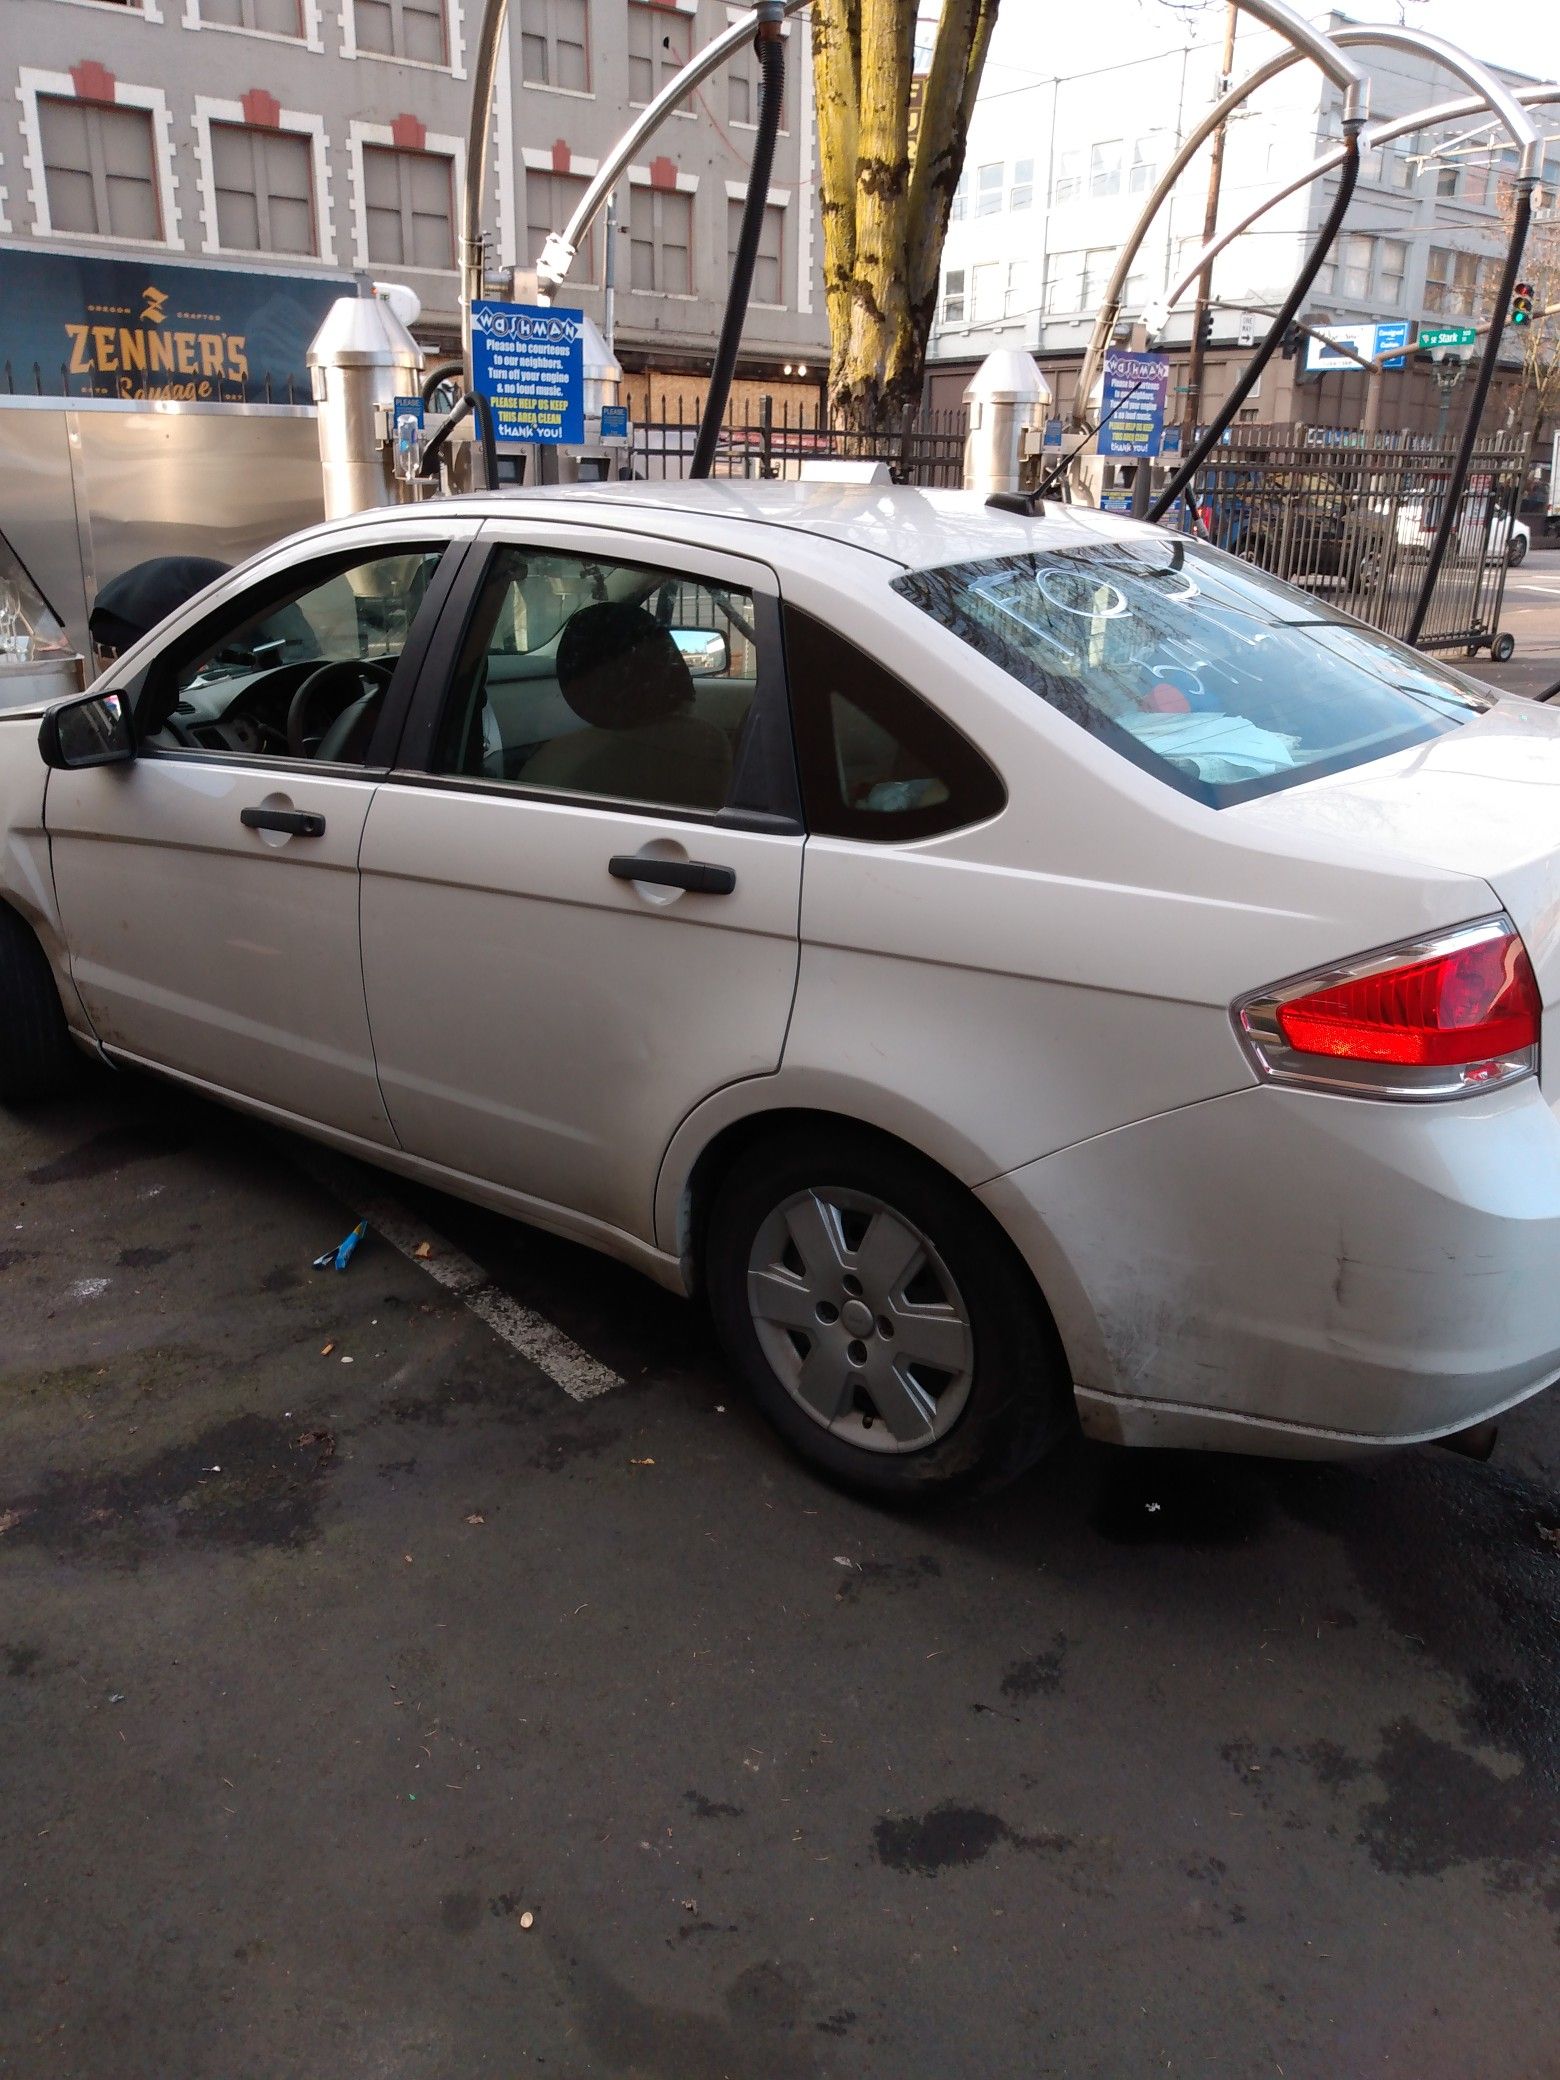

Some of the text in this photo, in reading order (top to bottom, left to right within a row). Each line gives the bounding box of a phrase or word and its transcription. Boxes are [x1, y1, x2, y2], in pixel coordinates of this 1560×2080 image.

[1438, 332, 1458, 344] Stark
[65, 323, 248, 382] ZENNER'S
[486, 338, 570, 356] Please be courteous
[493, 354, 564, 370] to our neighbors.
[488, 367, 570, 384] Turn off your engine
[496, 382, 563, 397] & no loud music.
[490, 396, 569, 411] PLEASE HELP US KEEP
[498, 411, 562, 424] THIS AREA CLEAN
[537, 426, 563, 438] YOU!
